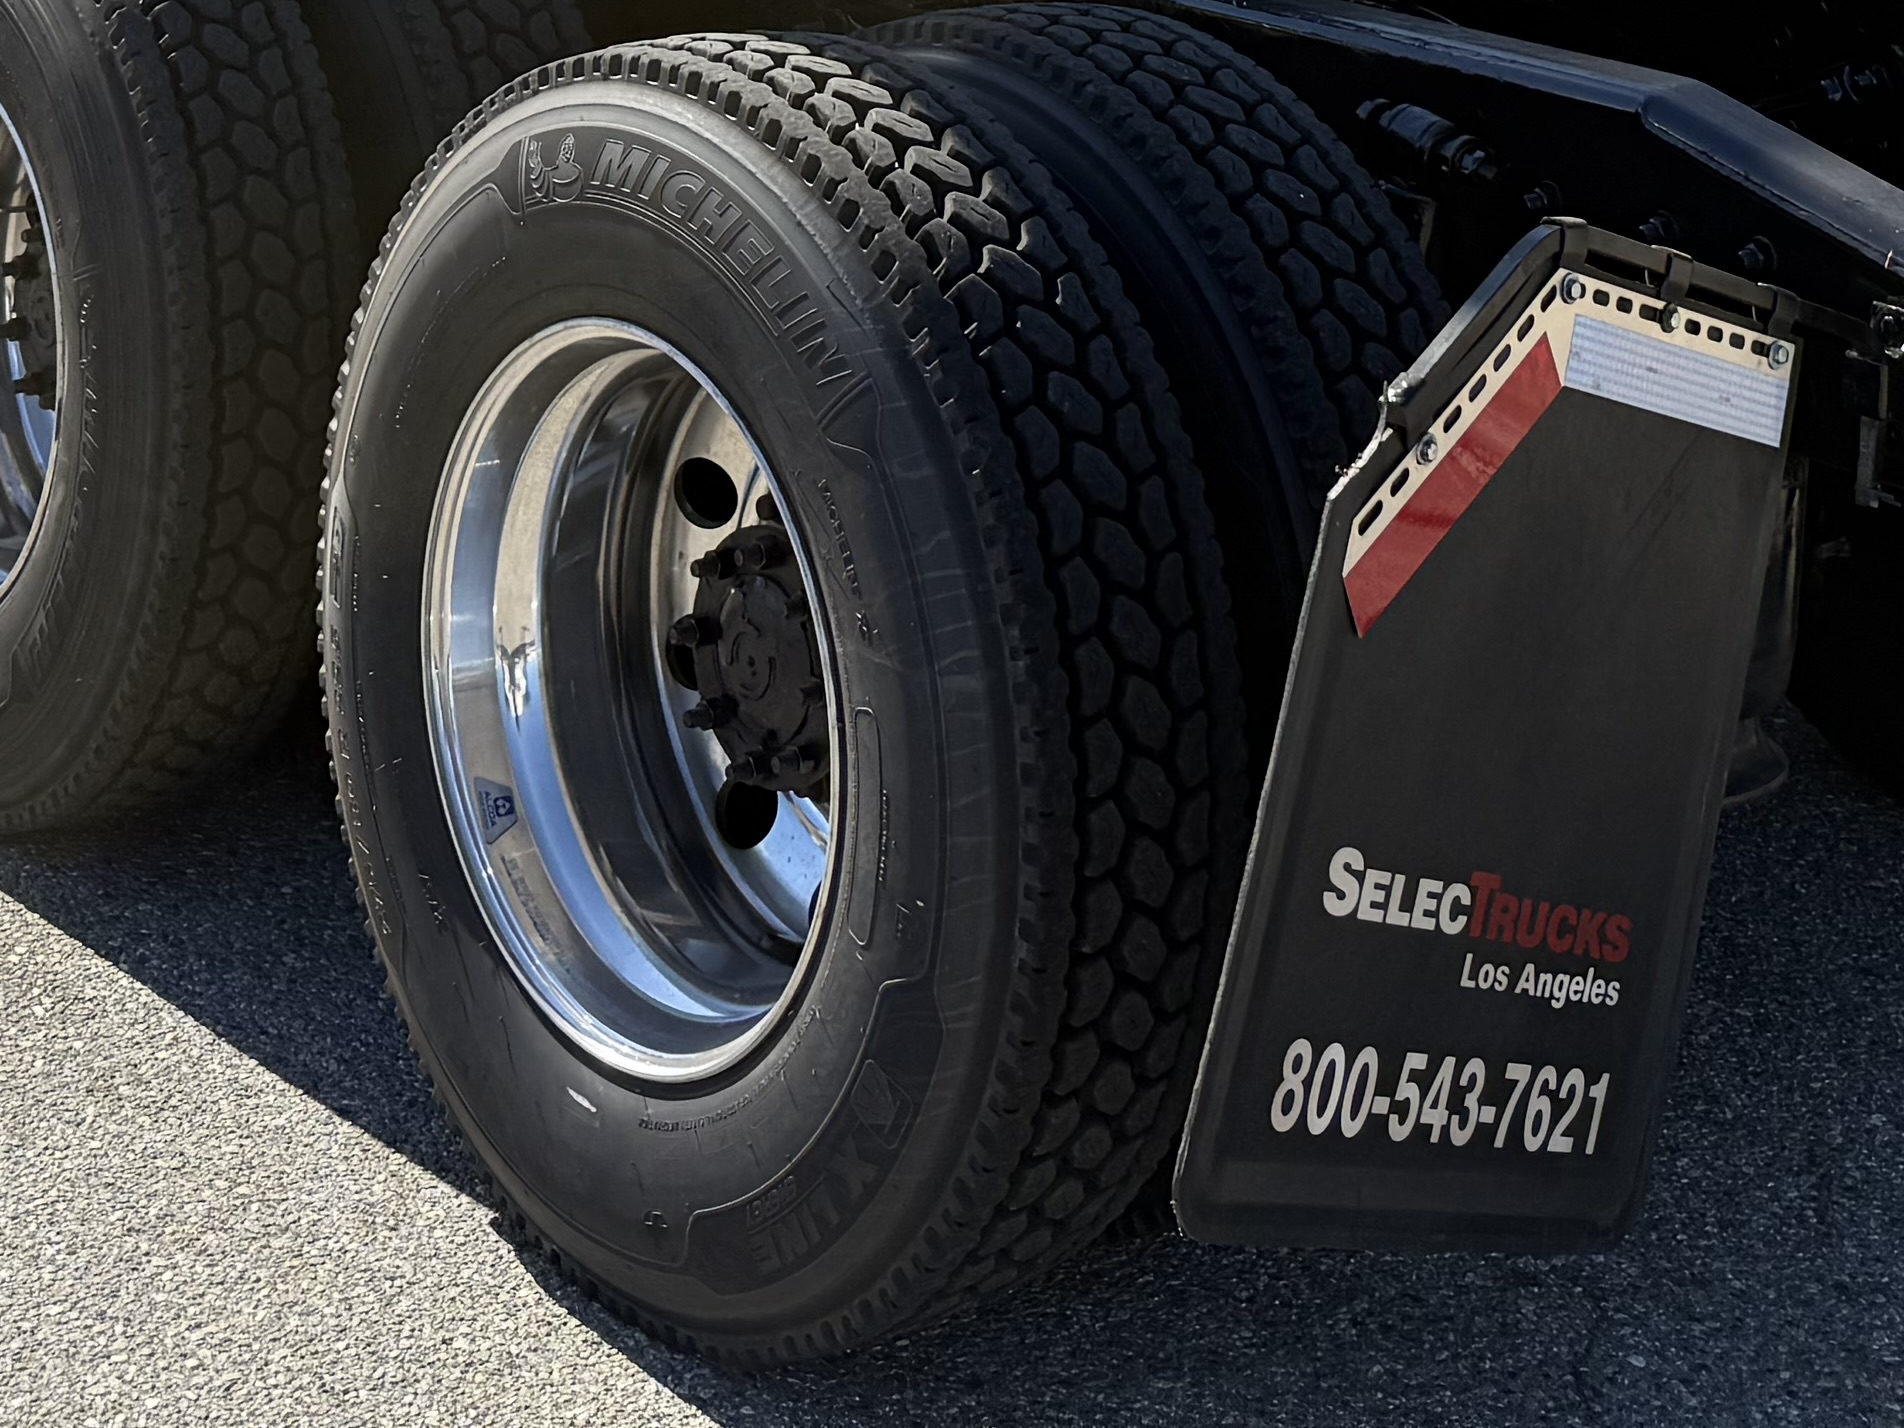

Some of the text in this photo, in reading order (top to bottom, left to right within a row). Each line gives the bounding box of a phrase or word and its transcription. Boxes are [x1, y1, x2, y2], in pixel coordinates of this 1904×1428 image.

[590, 138, 853, 387] MICHELIN
[1322, 846, 1634, 963] SELECTRUCKS
[1459, 952, 1621, 1009] Los Angeles
[1270, 1037, 1611, 1156] 800-543-7621
